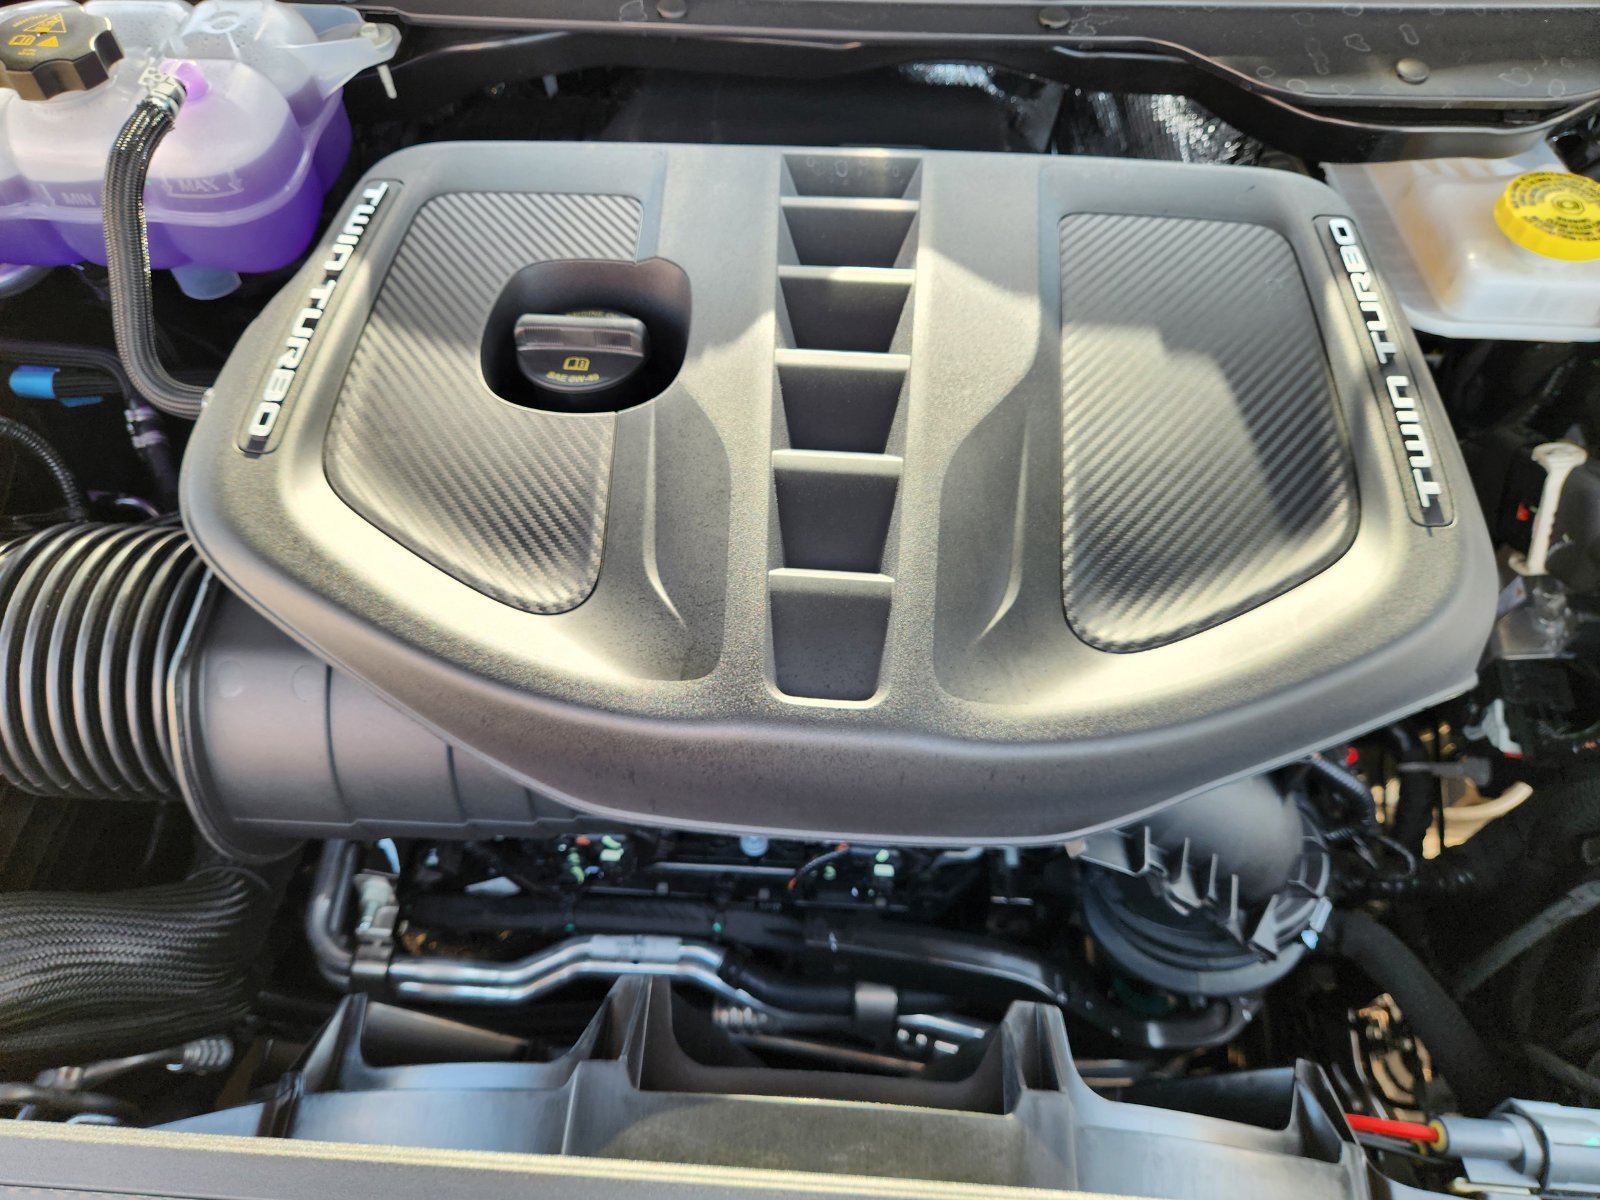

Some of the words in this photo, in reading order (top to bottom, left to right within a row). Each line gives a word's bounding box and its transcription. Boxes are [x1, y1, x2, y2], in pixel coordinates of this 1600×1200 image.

[62, 192, 97, 206] MIN
[178, 178, 220, 193] MAX
[324, 181, 388, 271] TWIN
[1329, 218, 1397, 364] TURBO
[249, 279, 337, 437] TURBO
[1386, 375, 1441, 508] TWIN
